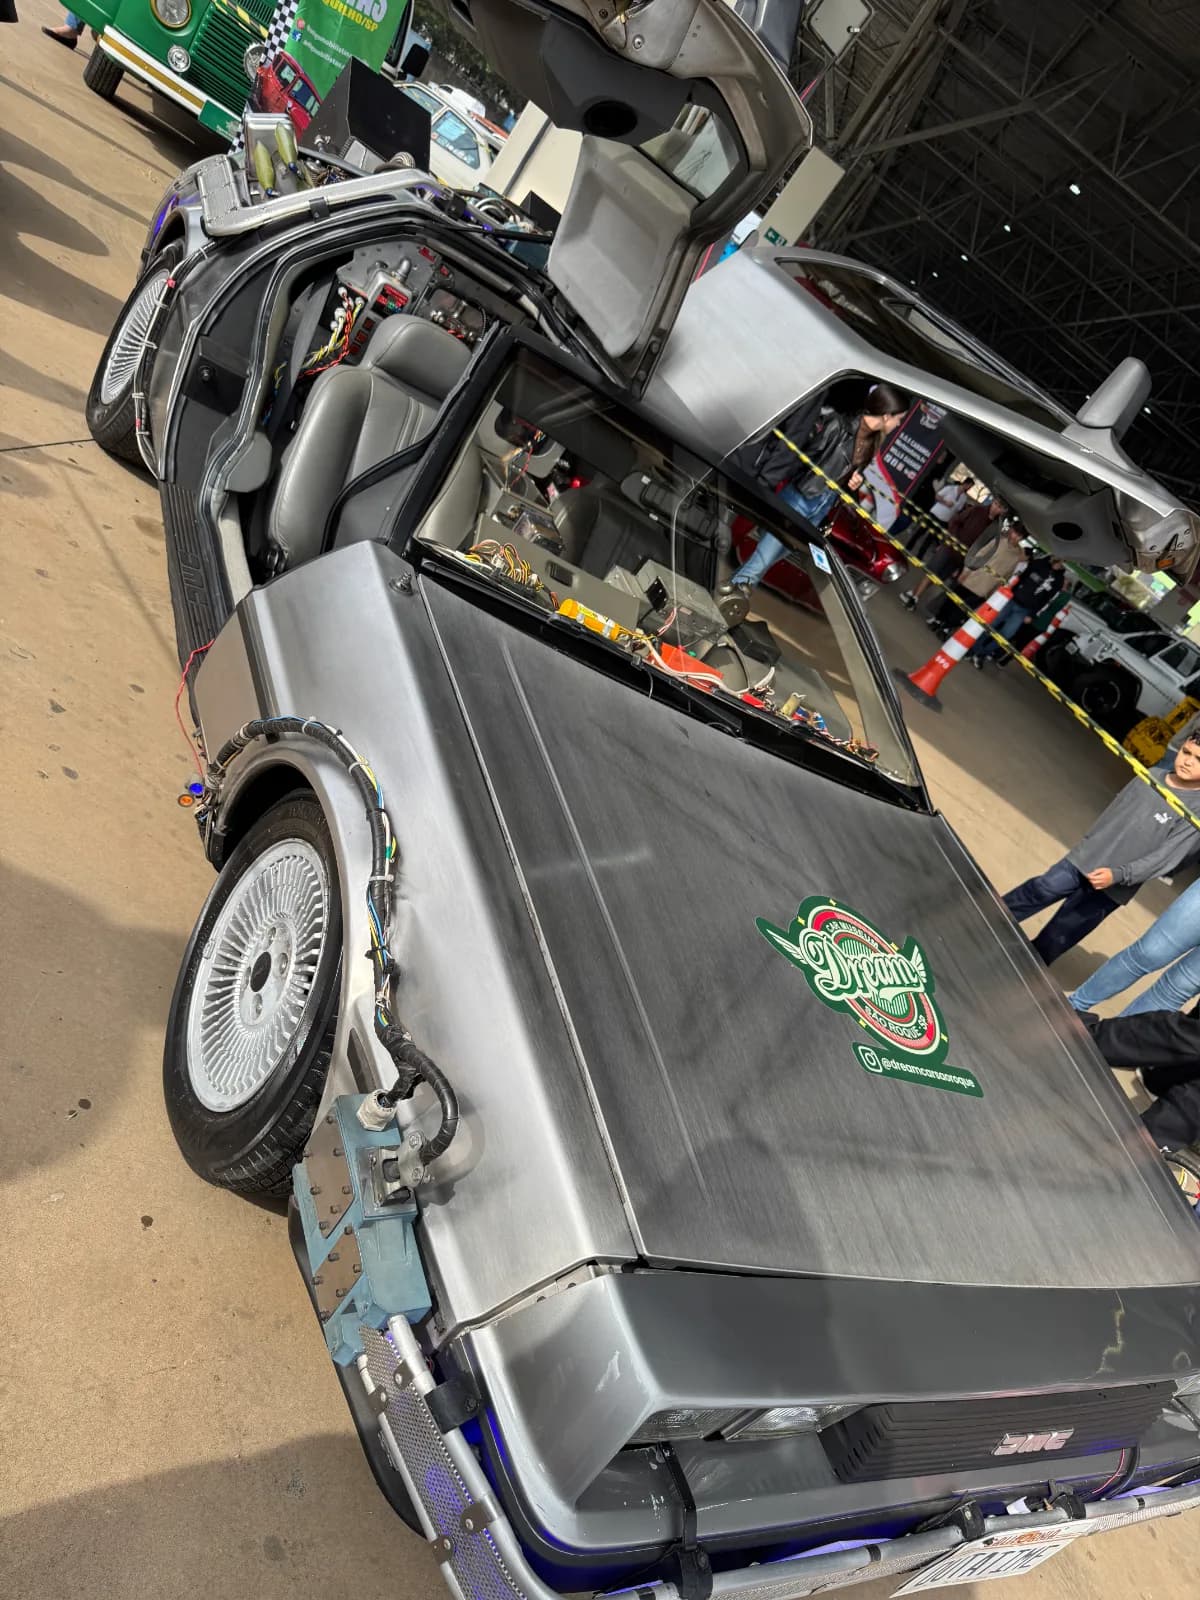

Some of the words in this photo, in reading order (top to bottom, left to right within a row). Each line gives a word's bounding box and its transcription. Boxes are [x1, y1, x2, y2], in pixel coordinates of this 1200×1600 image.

[800, 929, 922, 1001] Dream
[888, 1021, 921, 1038] ROQUE
[881, 1057, 975, 1089] @dreamcarsaoroque
[991, 1428, 1074, 1456] DMC
[914, 1544, 1060, 1587] OUTATIME
